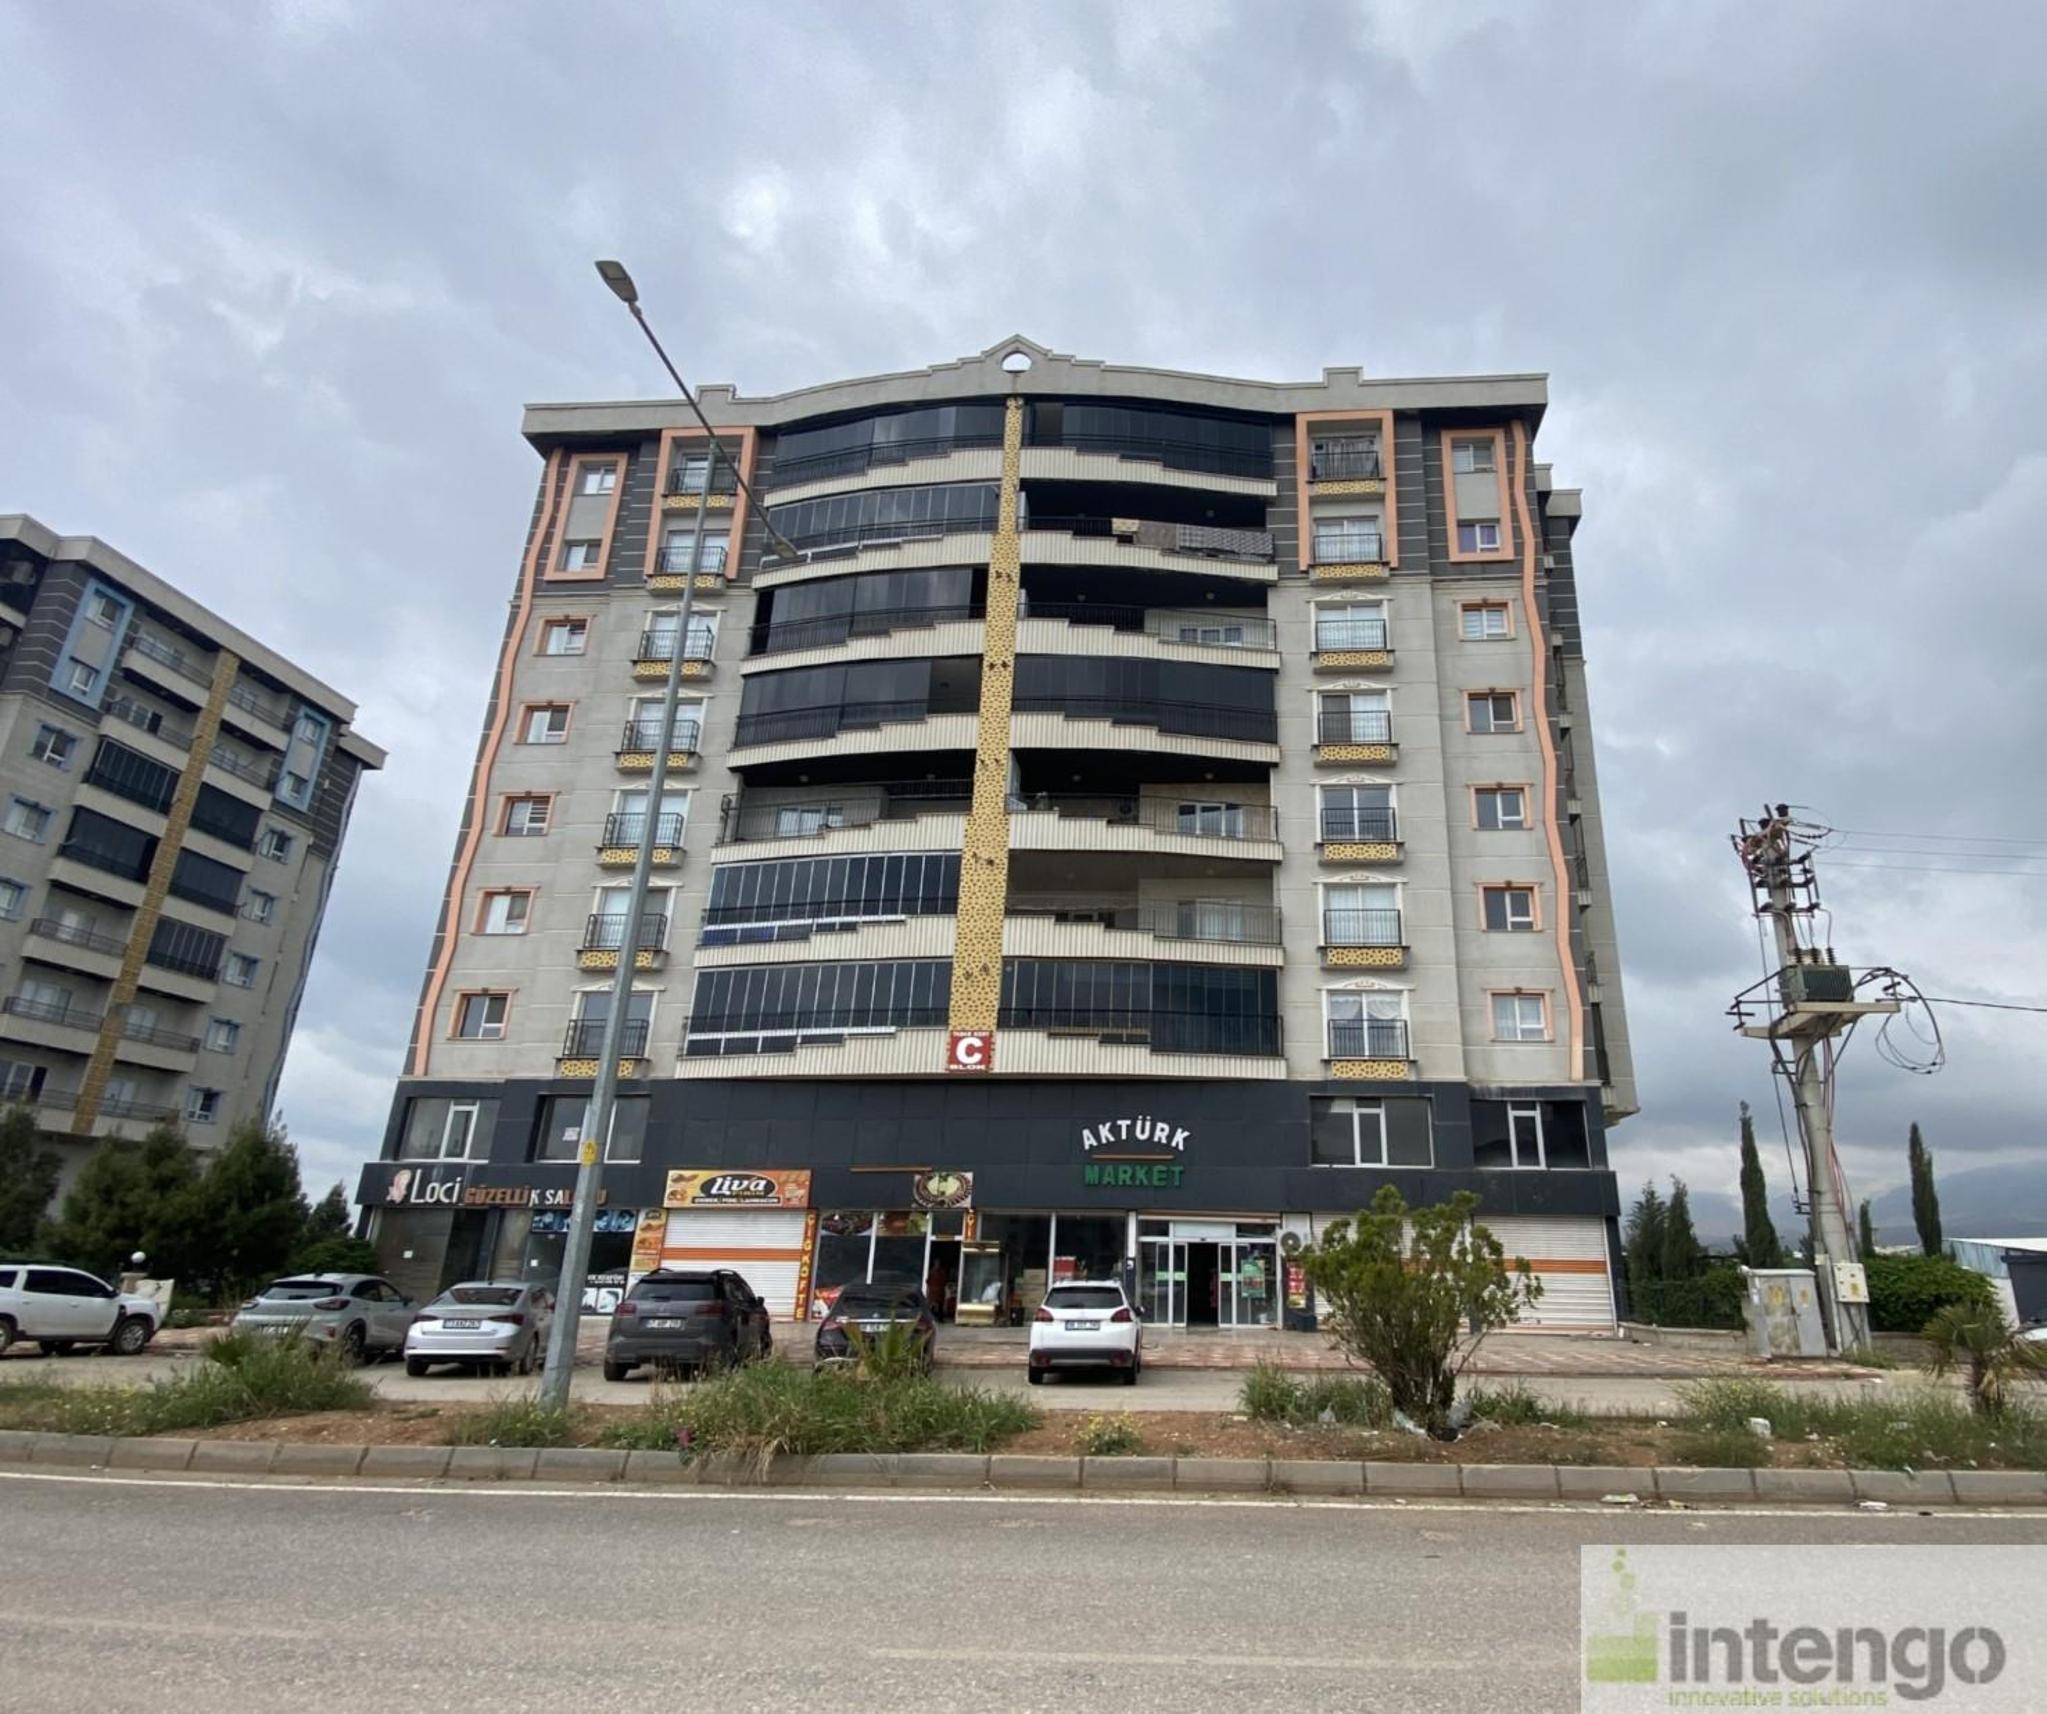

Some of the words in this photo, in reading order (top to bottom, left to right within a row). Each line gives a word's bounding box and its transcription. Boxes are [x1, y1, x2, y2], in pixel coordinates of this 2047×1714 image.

[955, 1036, 984, 1065] C
[1081, 1115, 1191, 1151] AKTÜRK
[1084, 1164, 1184, 1187] MARKET
